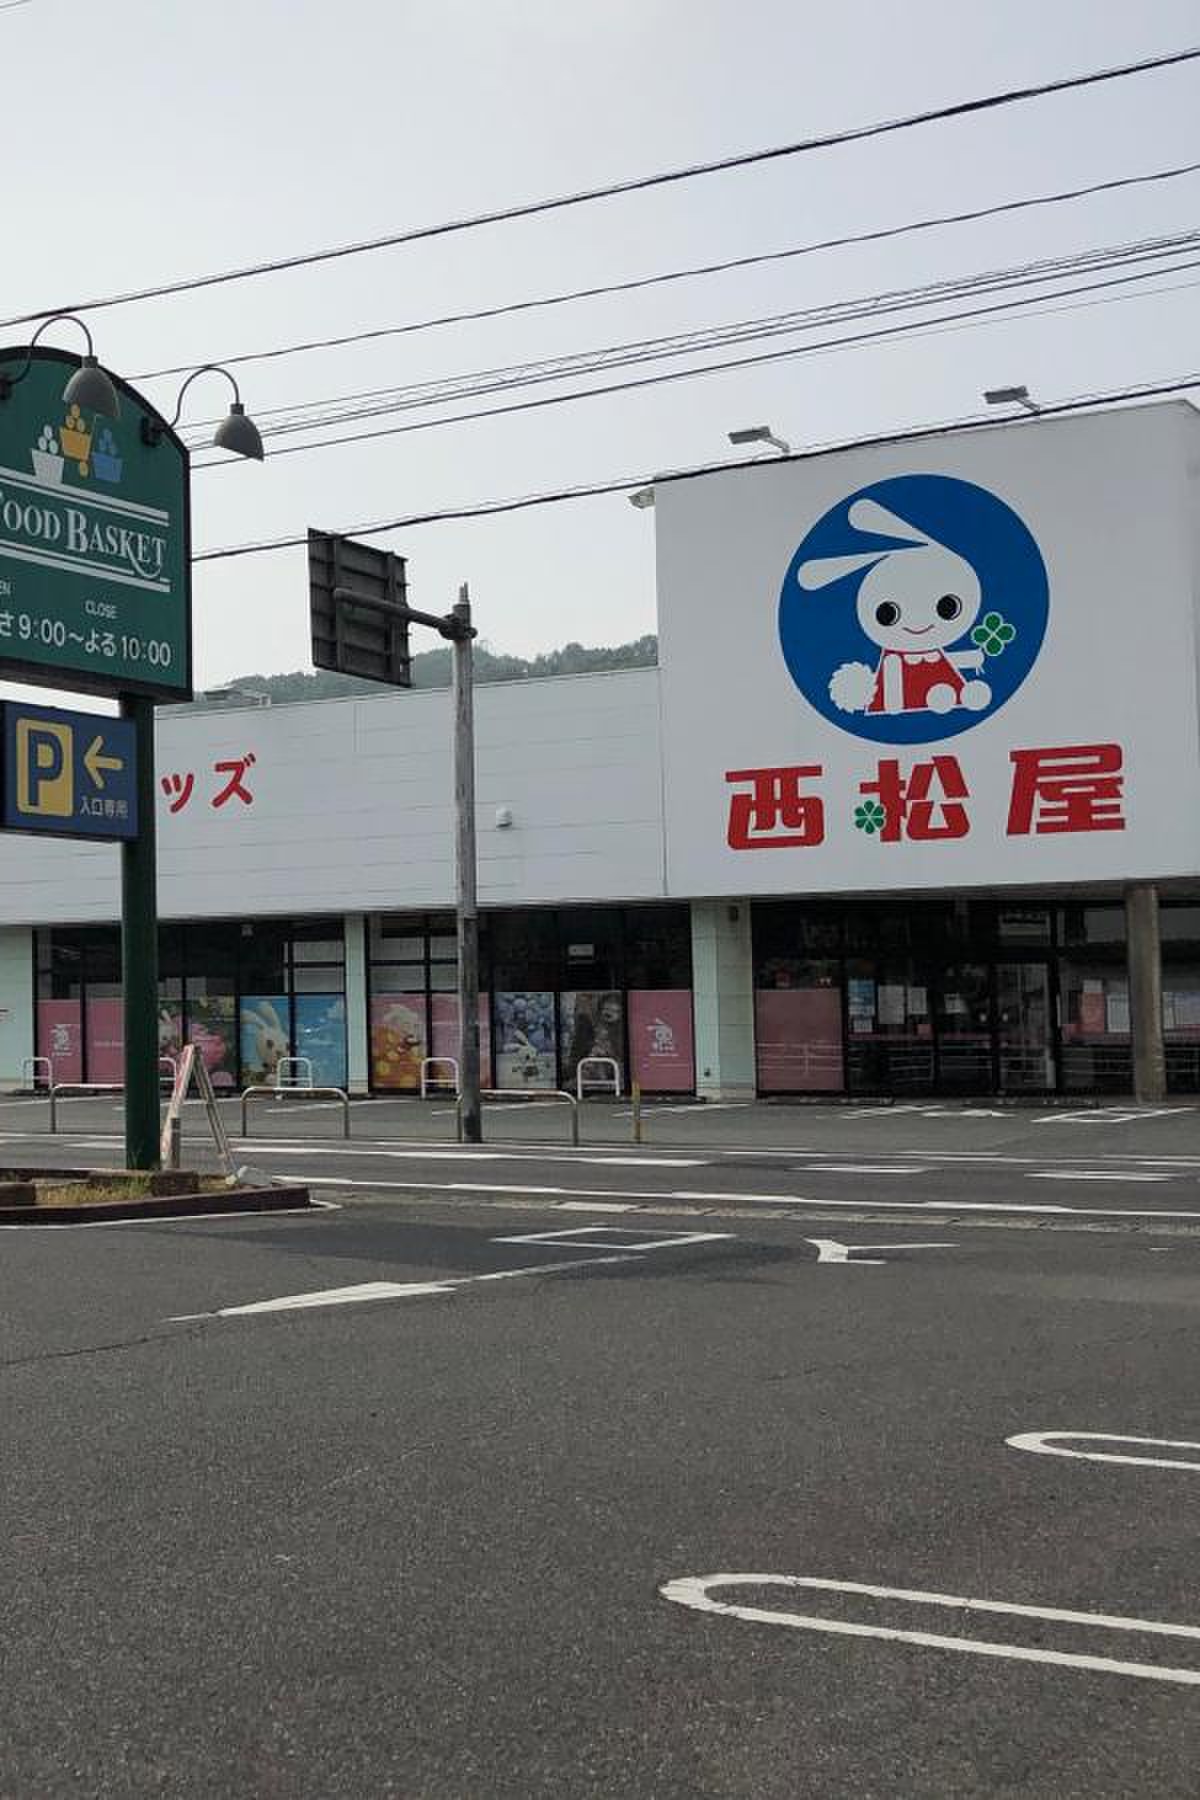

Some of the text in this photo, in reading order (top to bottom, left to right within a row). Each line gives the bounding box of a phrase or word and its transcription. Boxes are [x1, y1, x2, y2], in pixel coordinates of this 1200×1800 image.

[65, 508, 176, 578] BASKET
[85, 600, 118, 620] CLOSE
[28, 729, 63, 806] P
[724, 743, 1126, 851] 西松屋
